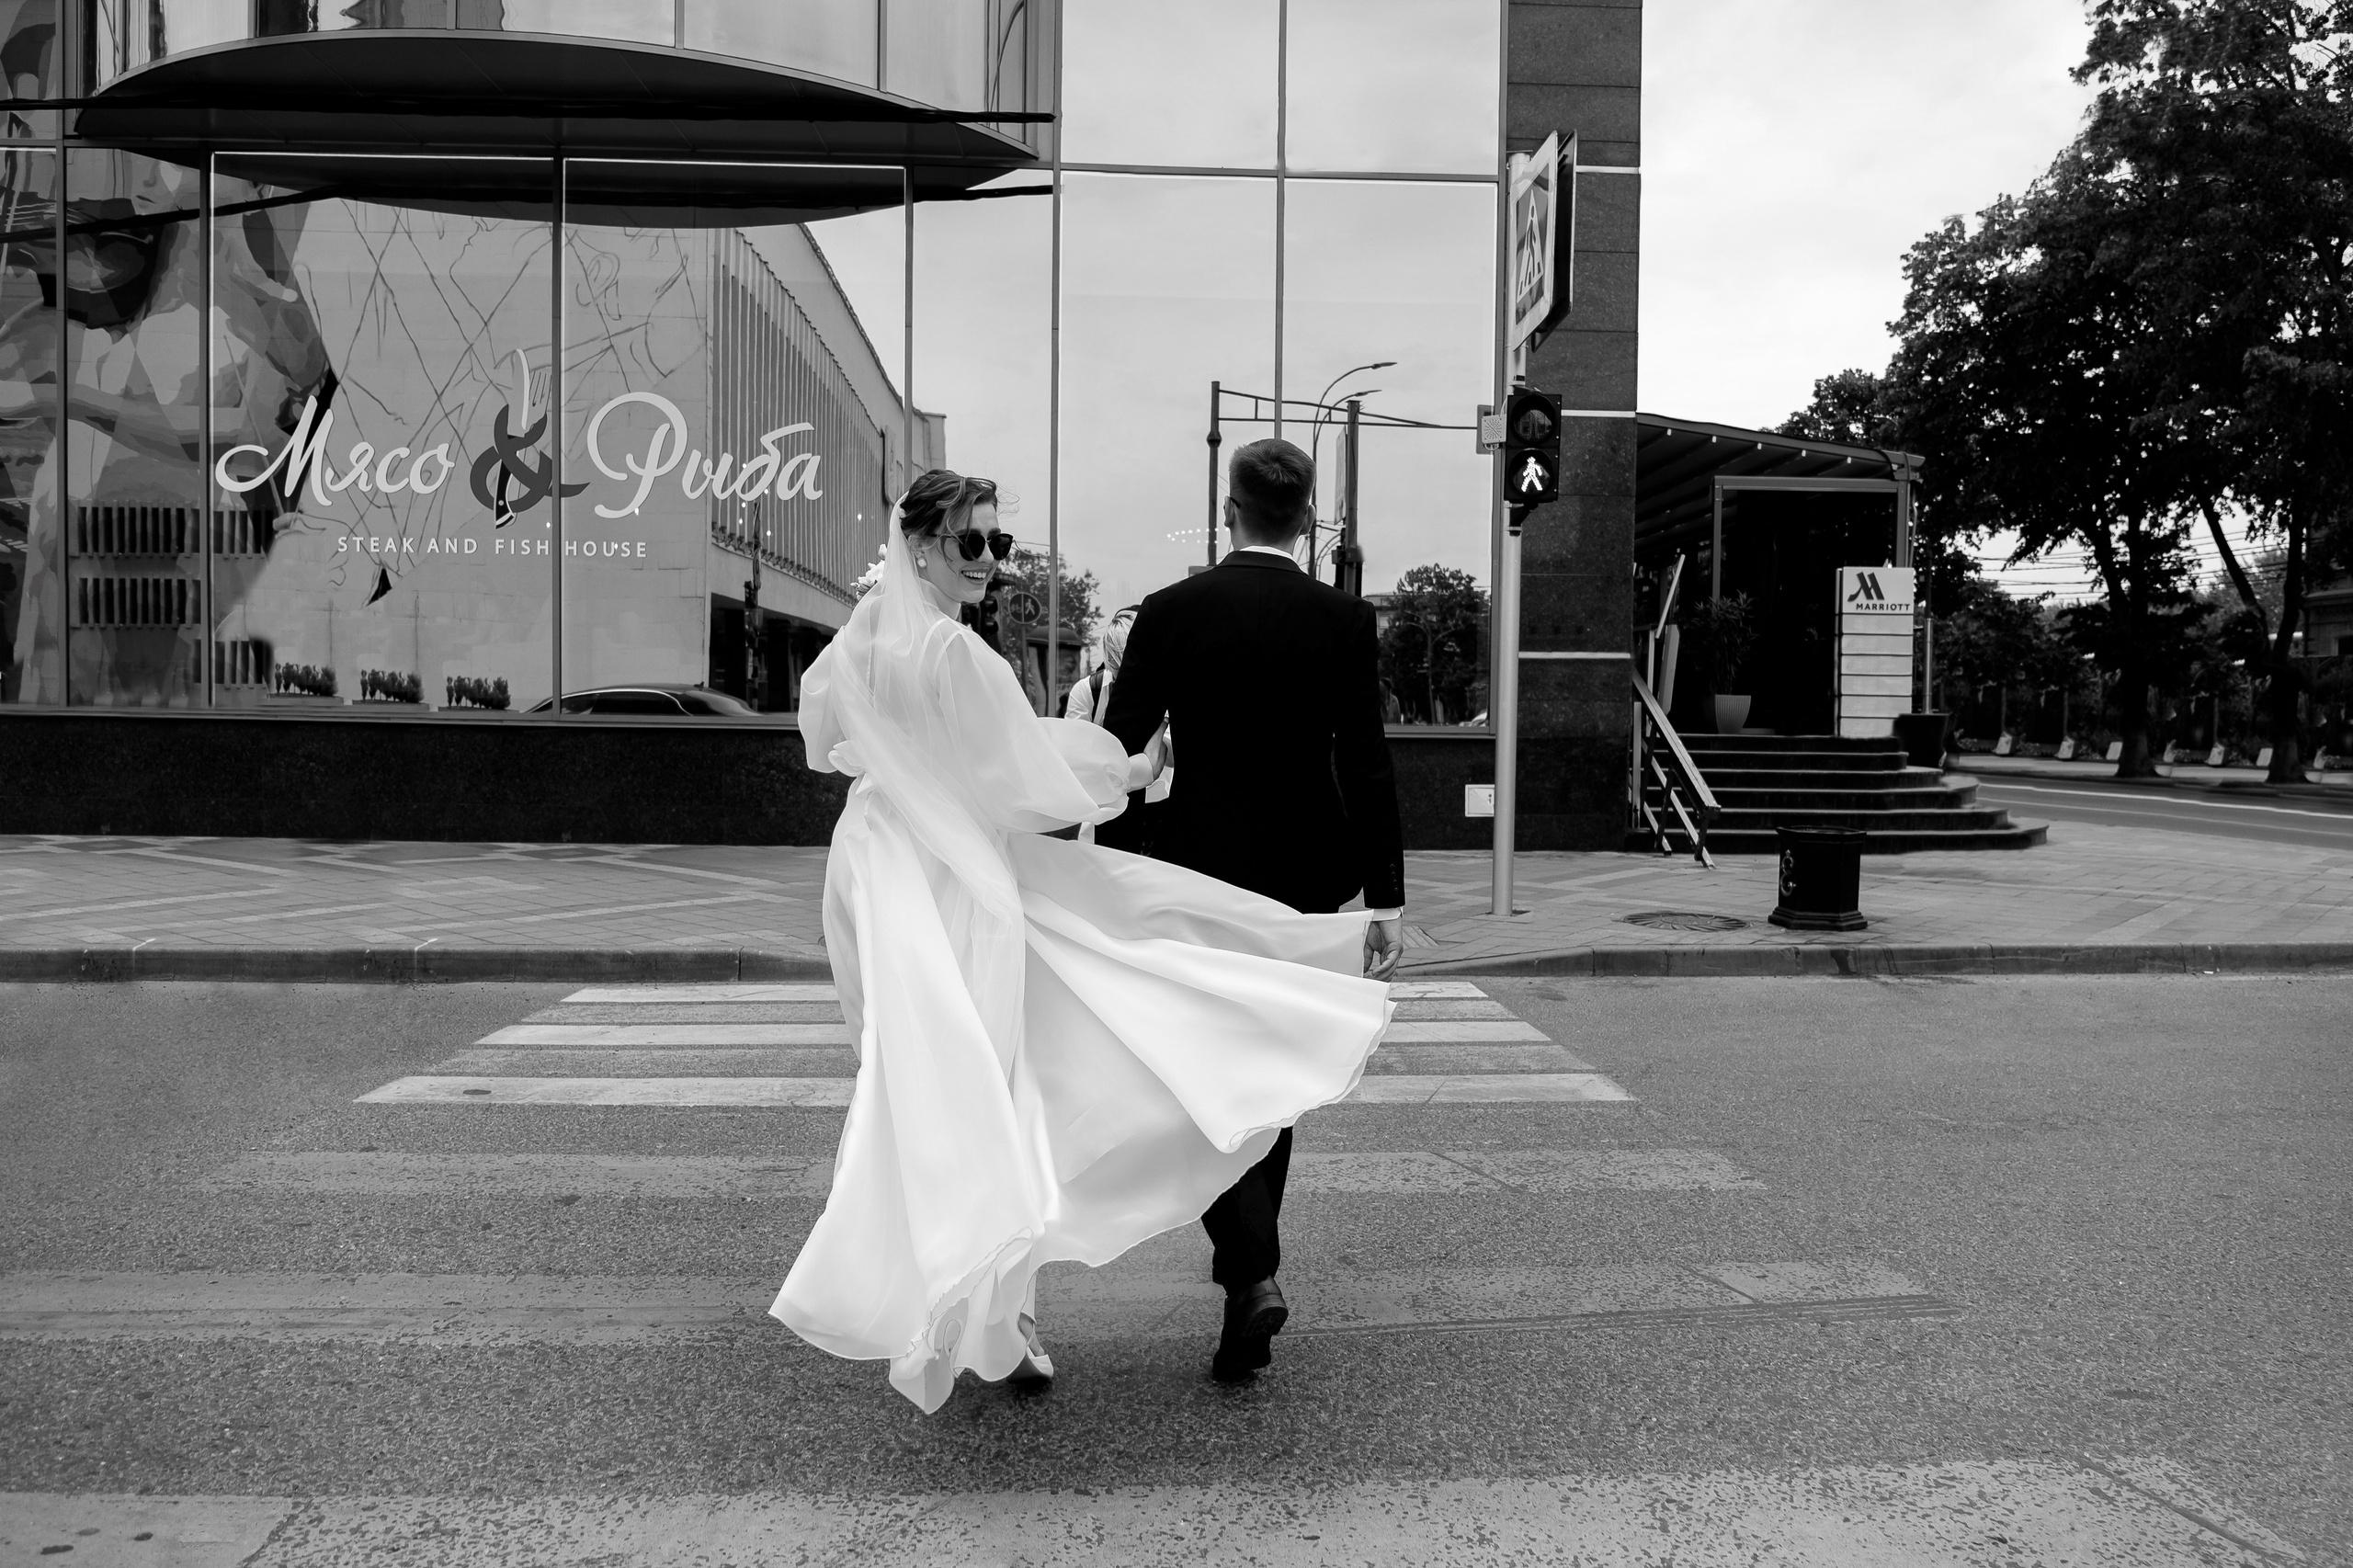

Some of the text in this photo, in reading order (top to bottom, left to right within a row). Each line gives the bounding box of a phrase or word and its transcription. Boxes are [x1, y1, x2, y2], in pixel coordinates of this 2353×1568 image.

[214, 394, 456, 506] Мясо
[586, 391, 824, 519] Рыба
[336, 536, 648, 558] STEAK AND FISH HOUSE
